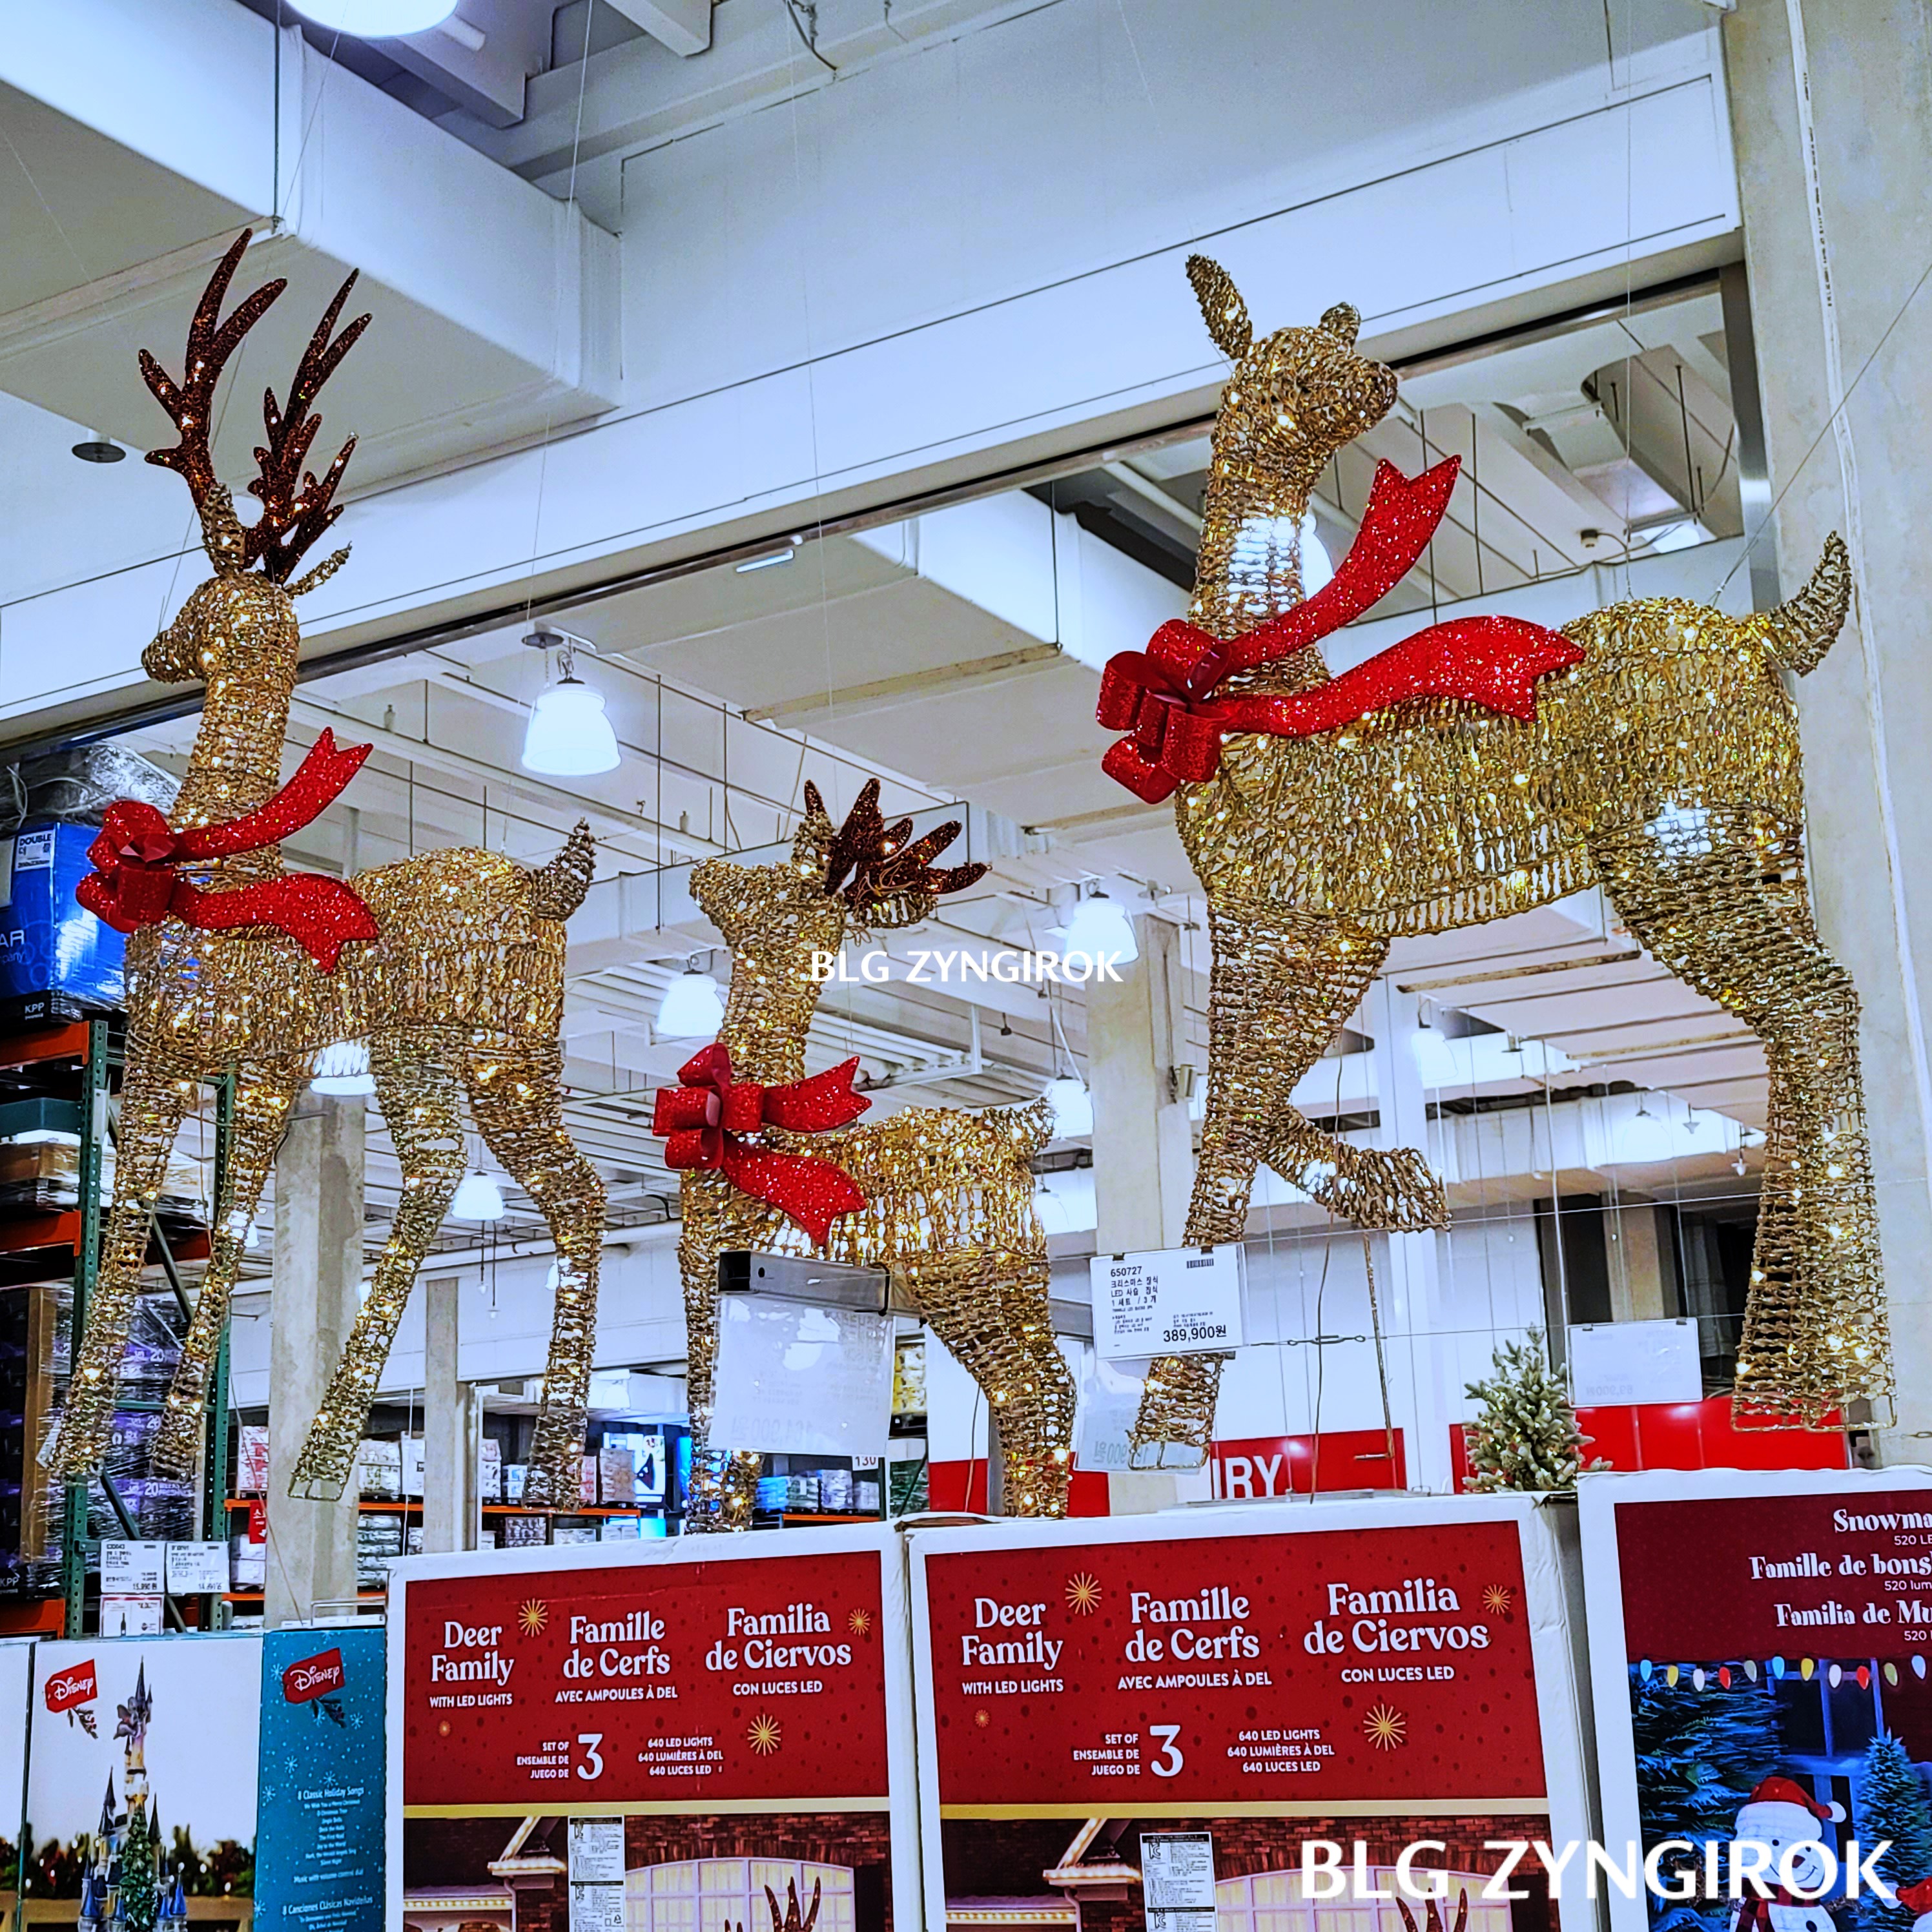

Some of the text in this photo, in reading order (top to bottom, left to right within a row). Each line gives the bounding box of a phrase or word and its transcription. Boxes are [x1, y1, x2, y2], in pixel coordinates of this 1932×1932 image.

[24, 1002, 45, 1014] KPP
[1111, 1266, 1142, 1277] 650727
[1111, 1278, 1143, 1288] 크리스마스
[1163, 1324, 1227, 1343] 389,900원
[1894, 1535, 1917, 1546] 520
[1748, 1552, 1832, 1579] Famille
[1838, 1554, 1867, 1576] de
[1884, 1580, 1907, 1591] 520
[1327, 1577, 1460, 1616] Familia
[974, 1598, 1046, 1628] Deer
[1131, 1587, 1249, 1623] Famille
[727, 1603, 831, 1637] Familia
[1774, 1600, 1856, 1627] Familia
[1862, 1603, 1891, 1624] de
[444, 1621, 502, 1648] Deer
[570, 1610, 666, 1644] Famille
[1125, 1625, 1260, 1662] de Cerfs
[1304, 1619, 1490, 1654] de Ciervos
[1904, 1630, 1927, 1641] 520
[705, 1639, 852, 1671] de Ciervos
[961, 1630, 1063, 1670] Family
[431, 1650, 515, 1686] Family
[563, 1645, 671, 1679] de Cerfs
[1118, 1669, 1272, 1690] AVEC AMPOULES À DEL
[1341, 1665, 1454, 1683] CON LUCES LED
[555, 1684, 678, 1703] AVEC AMPOULES À DEL
[733, 1680, 823, 1696] CON LUCES LED
[962, 1679, 1064, 1694] WITH LED LIGHTS
[429, 1693, 513, 1708] WITH LED LIGHTS
[648, 1736, 713, 1748] 640 LED LIGHTS
[1105, 1733, 1138, 1744] SET OF
[1238, 1729, 1320, 1741] 640 LED LIGHTS
[542, 1742, 570, 1751] SET OF
[1150, 1725, 1183, 1776] 3
[1227, 1742, 1335, 1757] 640 LUMIÈRES À DEL
[517, 1755, 569, 1765] ENSEMBLE DE
[577, 1733, 603, 1780] 3
[638, 1752, 654, 1762] 640
[707, 1750, 723, 1760] DEL
[1073, 1749, 1139, 1761] ENSEMBLE DE
[530, 1769, 569, 1779] JUEGO DE
[650, 1765, 712, 1776] 640 LUCES LED
[1091, 1765, 1140, 1776] JUEGO DE
[1243, 1761, 1321, 1773] 640 LUCES LED
